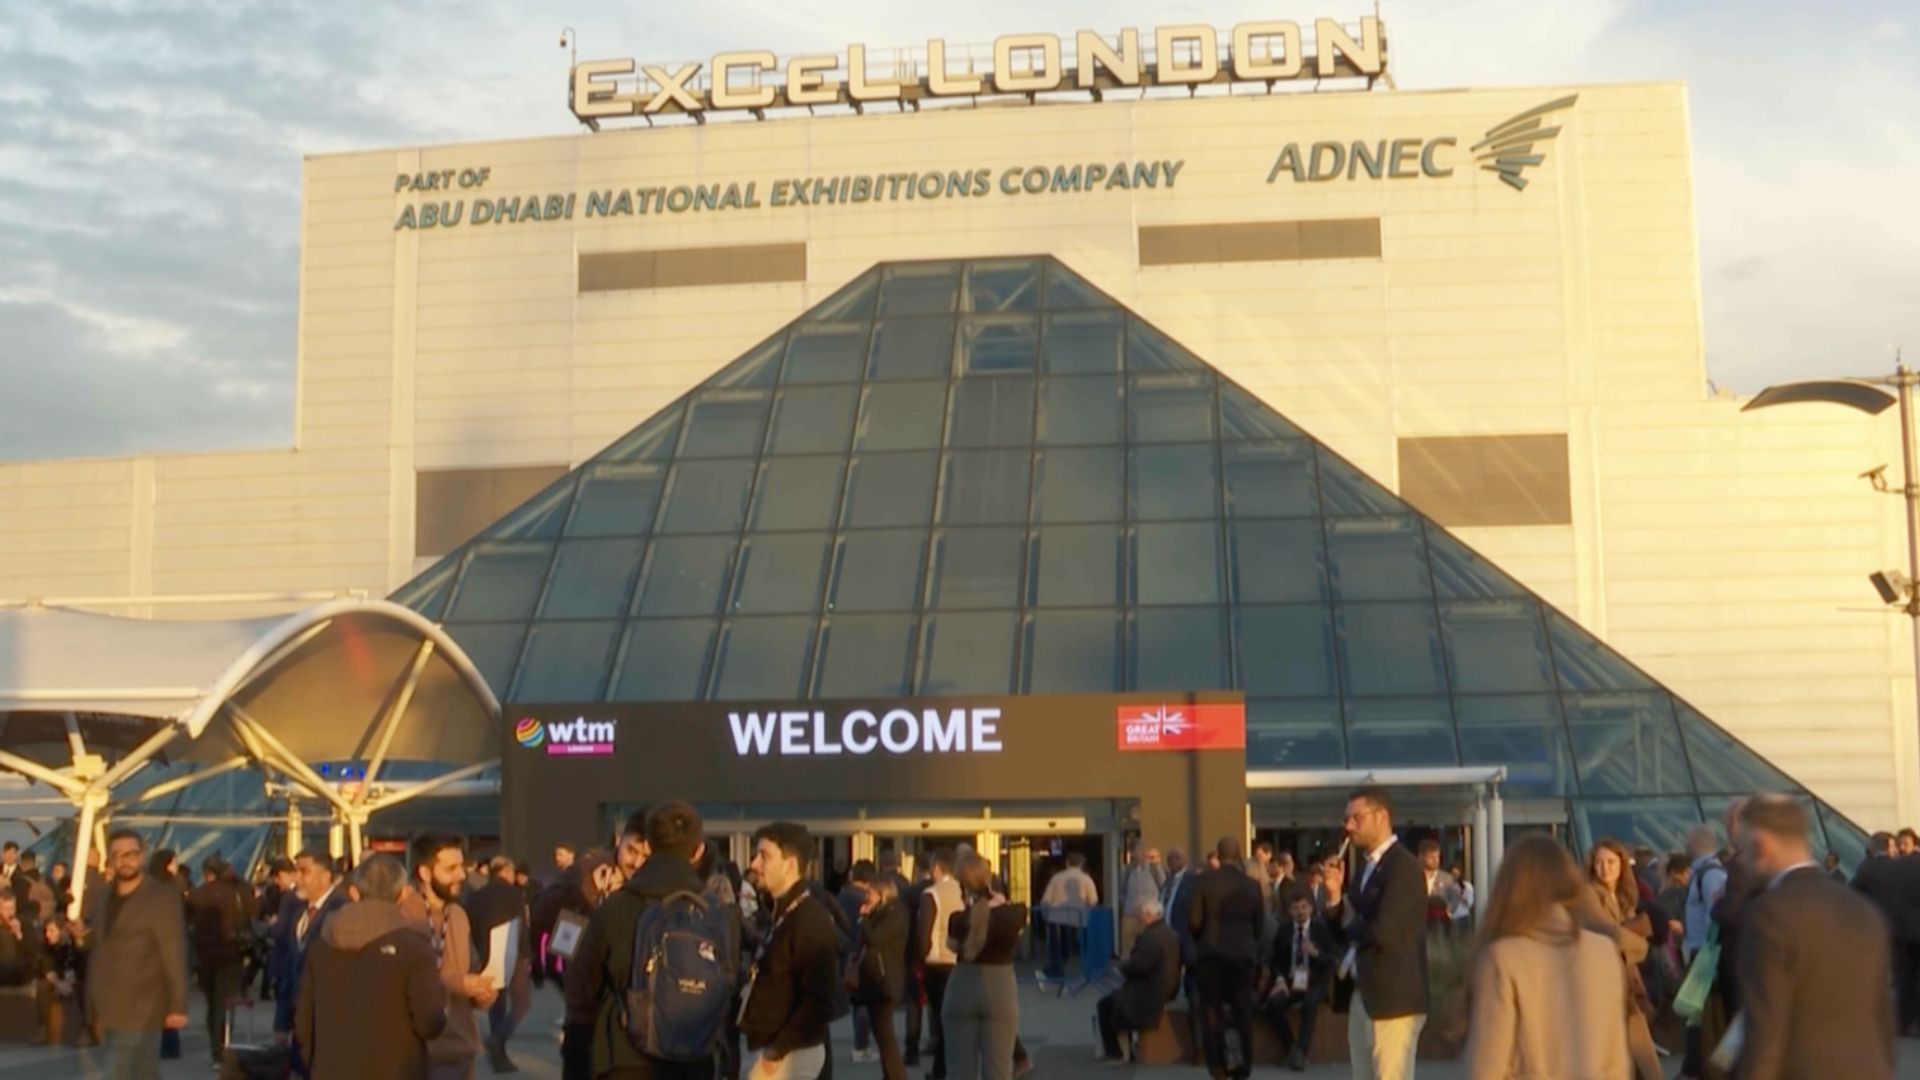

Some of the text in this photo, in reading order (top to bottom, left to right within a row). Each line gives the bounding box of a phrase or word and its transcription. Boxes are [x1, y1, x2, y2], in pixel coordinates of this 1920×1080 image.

[926, 15, 1382, 95] LONDON
[394, 167, 491, 193] PART OF
[1266, 136, 1458, 184] ADNEC
[394, 159, 1186, 231] ABU DHABI NATIONAL EXHIBITIONS COMPANY
[547, 716, 615, 743] wtm
[728, 707, 1003, 756] WELCOME
